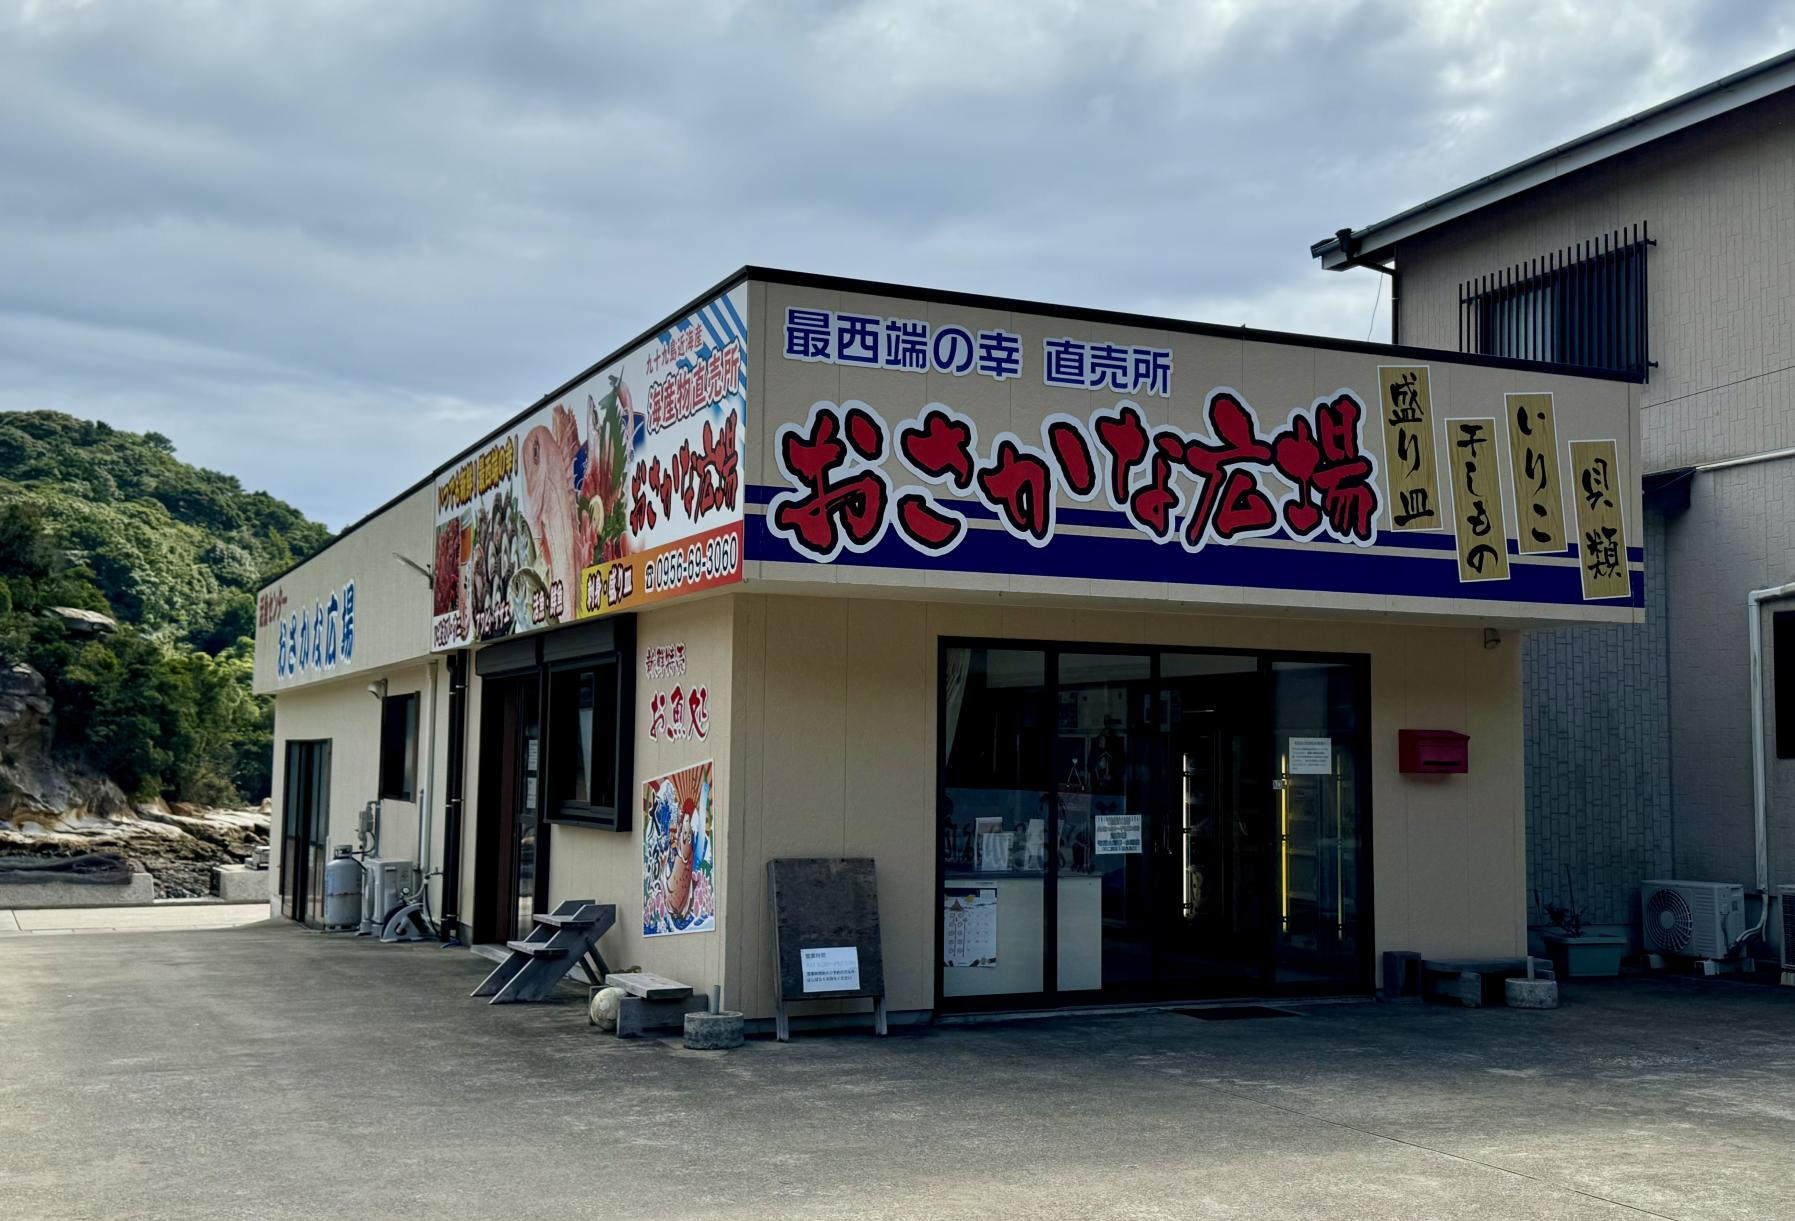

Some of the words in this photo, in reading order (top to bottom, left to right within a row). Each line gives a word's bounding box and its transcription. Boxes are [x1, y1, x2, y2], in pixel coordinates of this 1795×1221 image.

[646, 323, 703, 376] 九十九島近海産
[647, 338, 740, 433] 海産物直売所
[785, 308, 1021, 377] 最西端の幸
[1045, 339, 1171, 395] 直売所
[629, 408, 738, 537] おさかな広場
[773, 391, 1378, 554] おさかな広場
[1388, 371, 1435, 527] 盛り皿
[1456, 423, 1499, 574] 干しもの
[1516, 405, 1551, 543] いりこ
[655, 534, 737, 591] 0956-69-3060
[1582, 457, 1622, 580] 貝類
[278, 583, 354, 677] おさかな広場
[650, 685, 708, 740] お魚処
